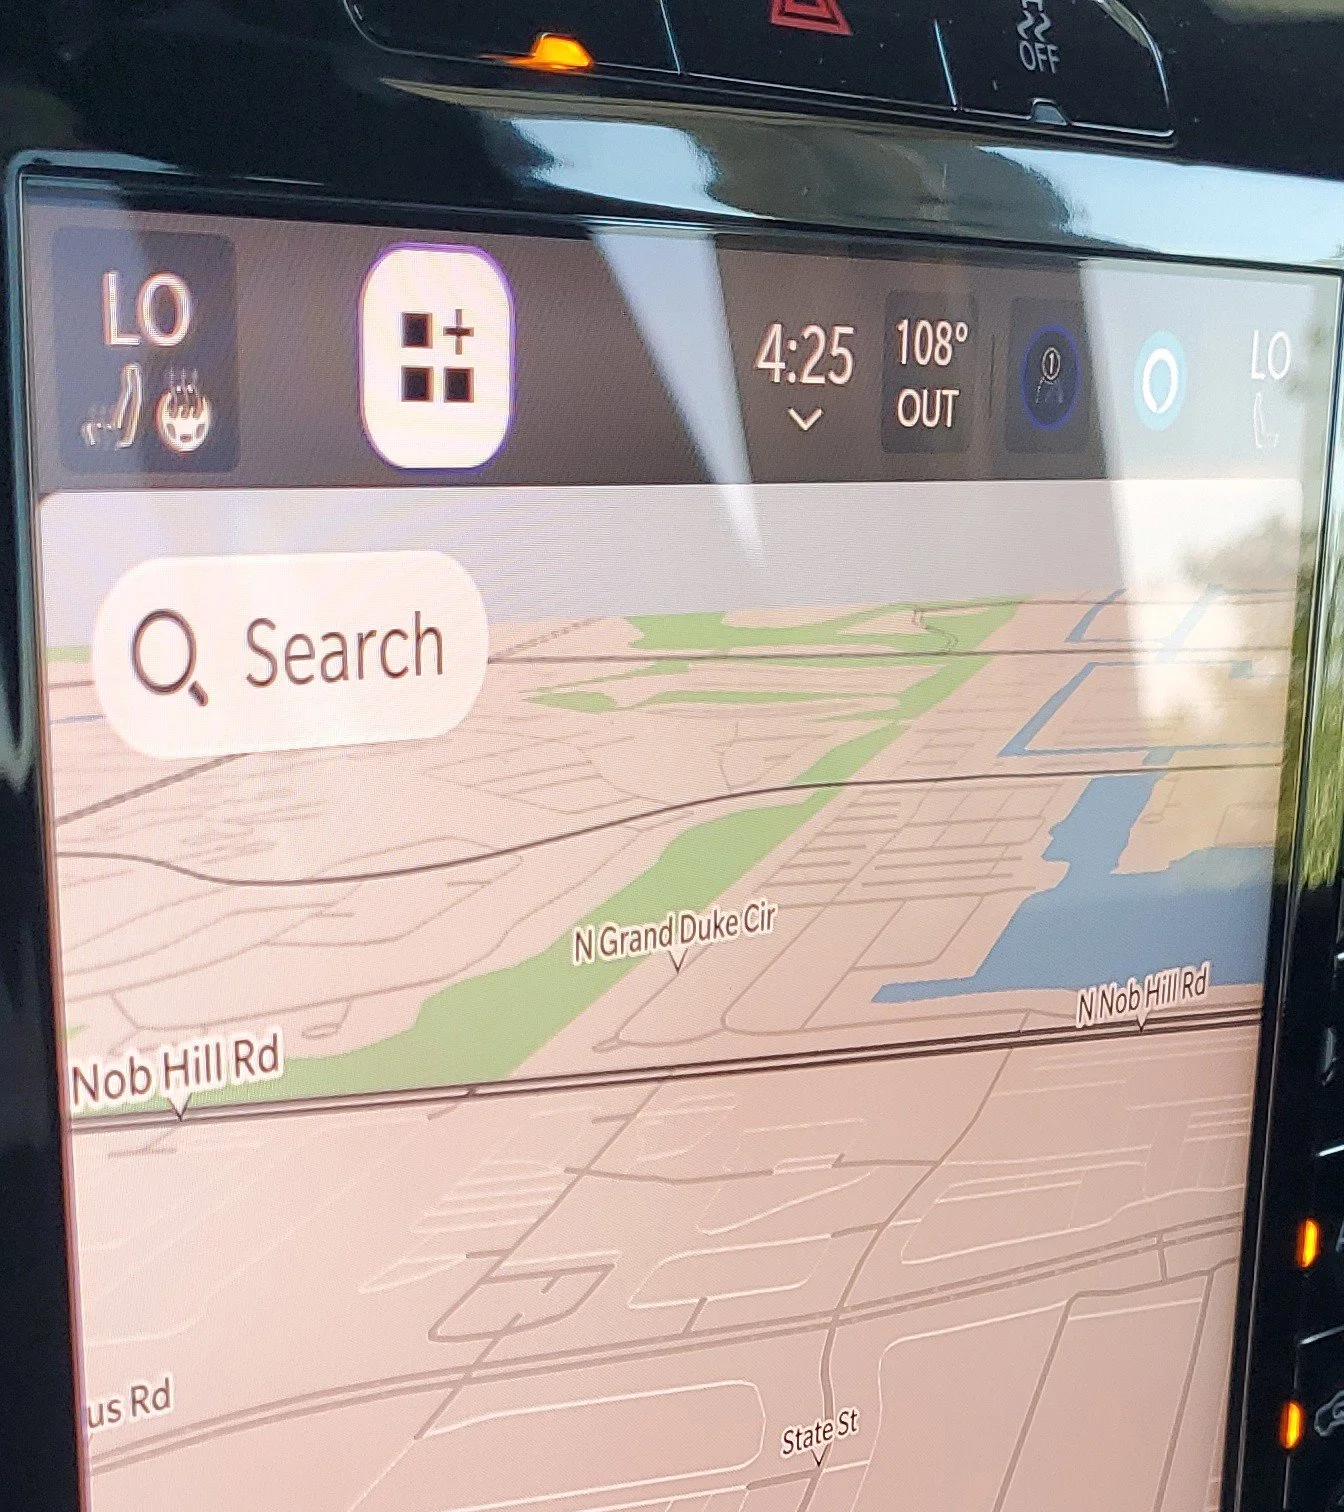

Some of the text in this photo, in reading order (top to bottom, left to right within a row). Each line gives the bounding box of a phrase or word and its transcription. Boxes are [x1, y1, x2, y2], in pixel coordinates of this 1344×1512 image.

[1019, 40, 1060, 74] OFF
[102, 270, 193, 347] LO
[757, 322, 856, 387] 4:25
[896, 319, 968, 367] 108°
[1250, 329, 1292, 381] LO
[897, 388, 960, 429] OUT
[244, 610, 445, 690] Search
[575, 901, 776, 963] N Grand Duke Cir
[1078, 965, 1208, 1024] N Nob Hill Rd
[72, 1032, 279, 1106] Nob Hill Rd
[130, 1376, 171, 1418] Rd
[782, 1408, 858, 1455] State St
